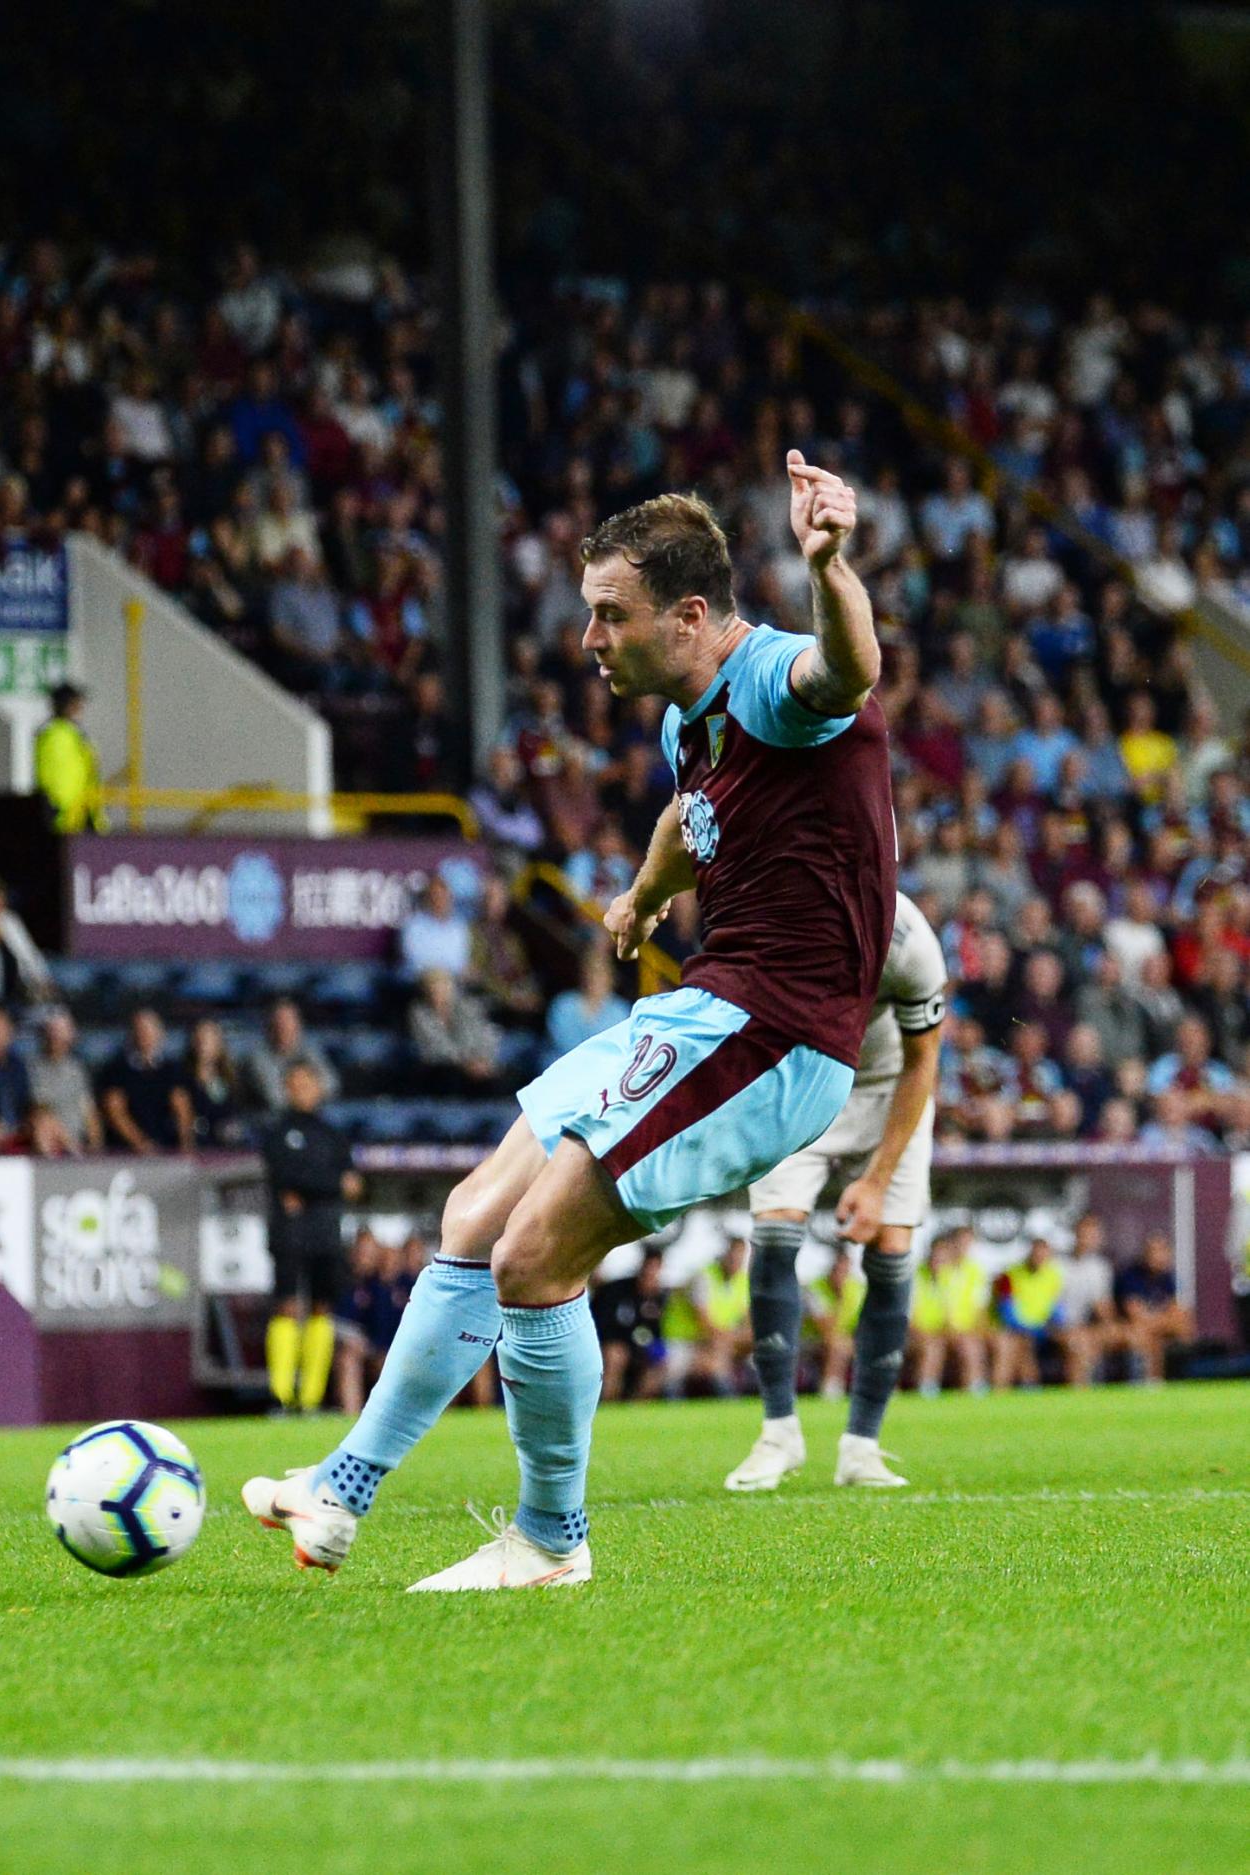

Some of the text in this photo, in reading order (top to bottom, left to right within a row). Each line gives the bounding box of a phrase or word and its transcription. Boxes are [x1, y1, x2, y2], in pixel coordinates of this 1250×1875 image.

[619, 1033, 678, 1102] 10
[41, 1169, 159, 1257] sofa
[41, 1252, 161, 1309] store
[457, 1330, 494, 1347] BFC
